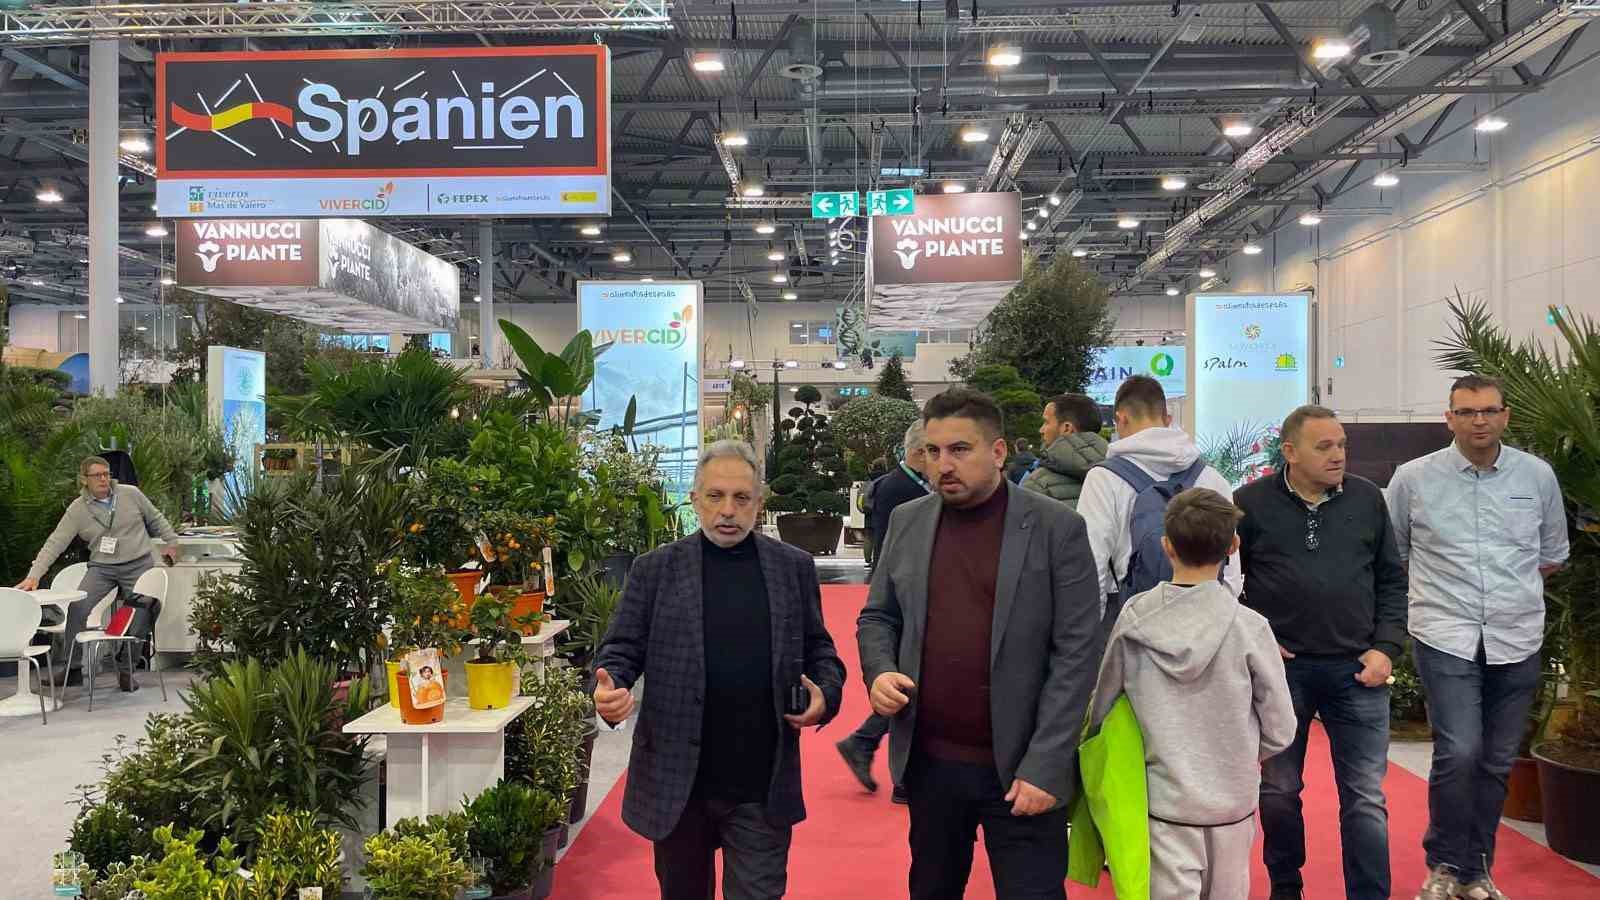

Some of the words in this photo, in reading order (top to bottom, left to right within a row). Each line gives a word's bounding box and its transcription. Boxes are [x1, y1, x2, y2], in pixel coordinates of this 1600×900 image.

[296, 81, 584, 156] Spanien
[319, 199, 386, 210] VIVERCID
[453, 192, 489, 203] FEPEX
[192, 221, 302, 240] VANNUCCI
[891, 215, 1003, 237] VANNUCCI
[226, 243, 303, 261] PIANTE
[925, 238, 1004, 257] PIANTE
[341, 254, 371, 281] PIANTE
[591, 328, 681, 345] VIVERCID
[1092, 366, 1133, 380] AIN
